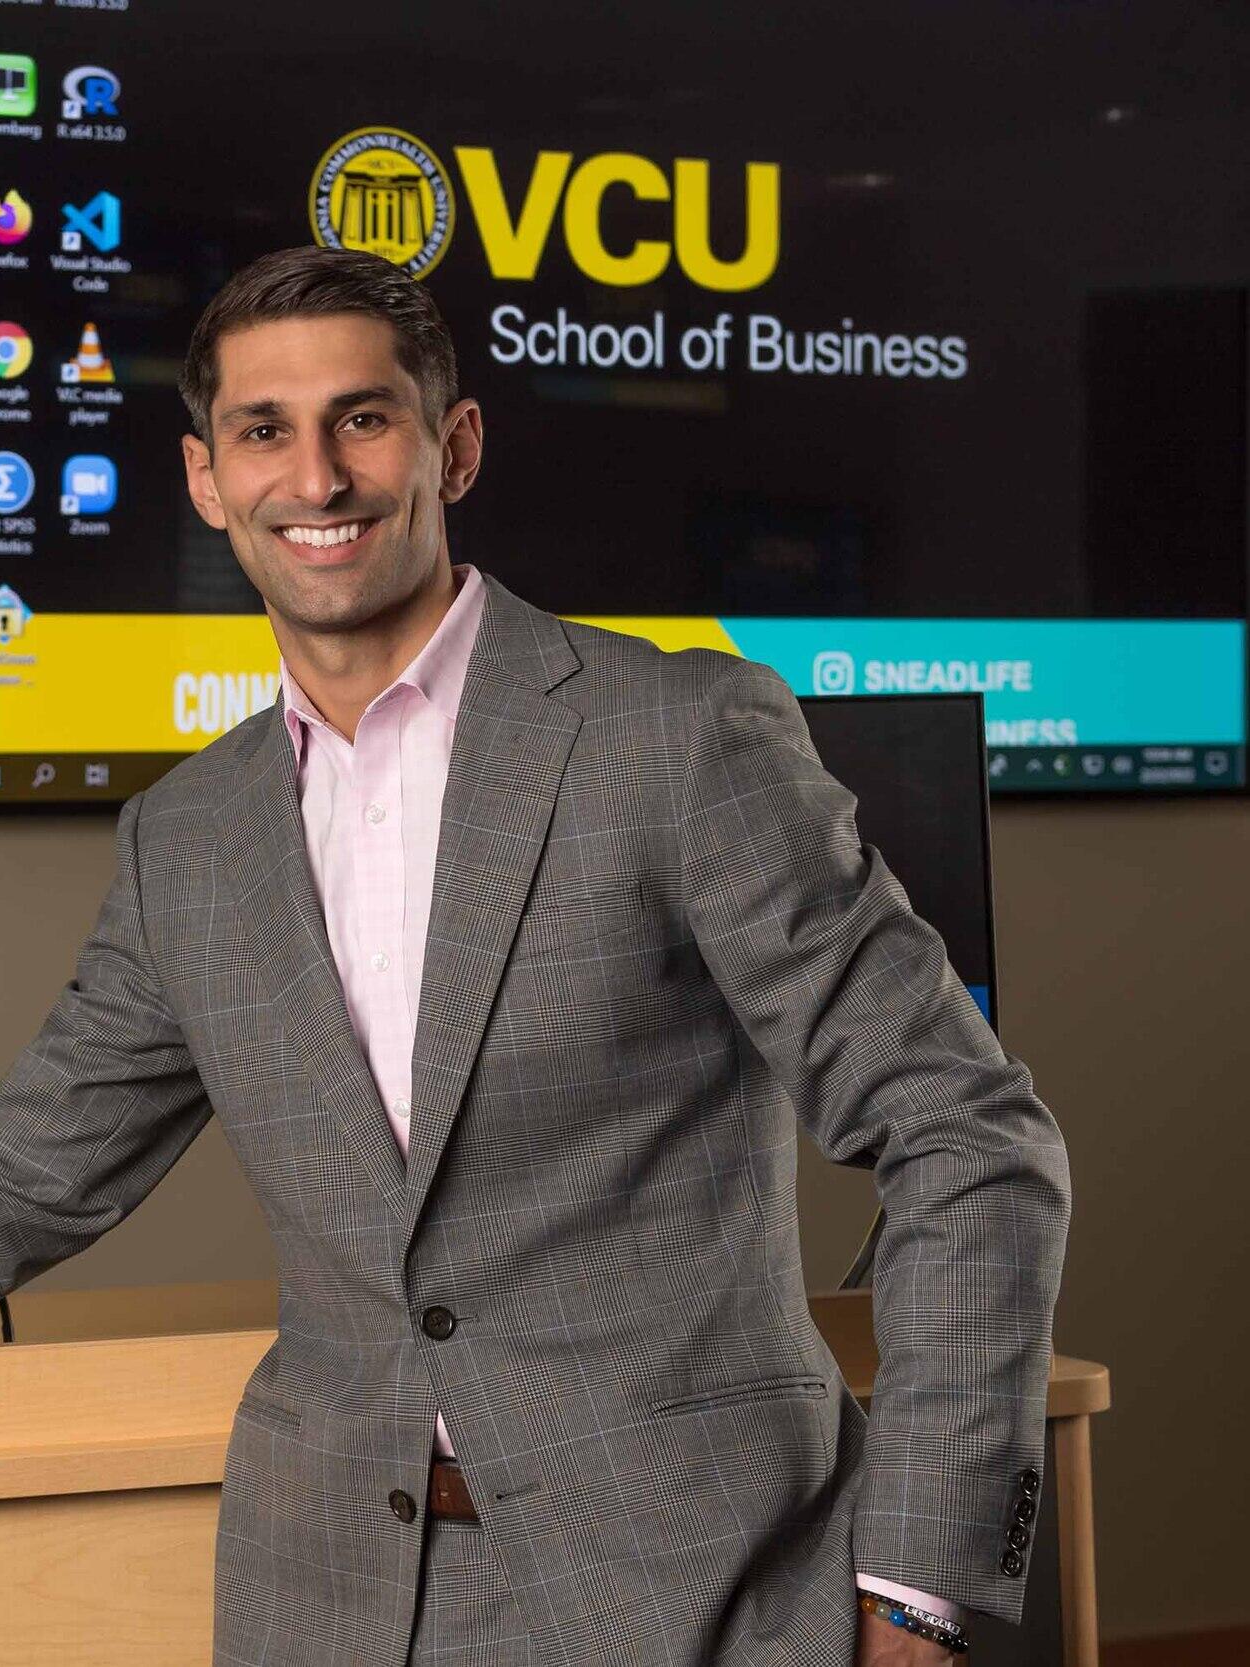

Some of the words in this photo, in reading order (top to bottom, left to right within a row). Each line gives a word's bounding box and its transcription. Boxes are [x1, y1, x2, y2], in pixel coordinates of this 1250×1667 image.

[454, 146, 781, 292] VCU
[51, 255, 87, 271] Visual
[88, 256, 132, 273] Studio
[72, 275, 108, 293] Code
[490, 305, 665, 368] School
[680, 314, 732, 371] of
[749, 315, 968, 379] Business
[83, 388, 123, 404] media
[69, 407, 108, 427] player
[2, 517, 36, 534] SPSS
[69, 518, 110, 535] Zoom
[864, 660, 1033, 692] SNEADLIFE
[906, 1605, 960, 1635] ELEVATE
